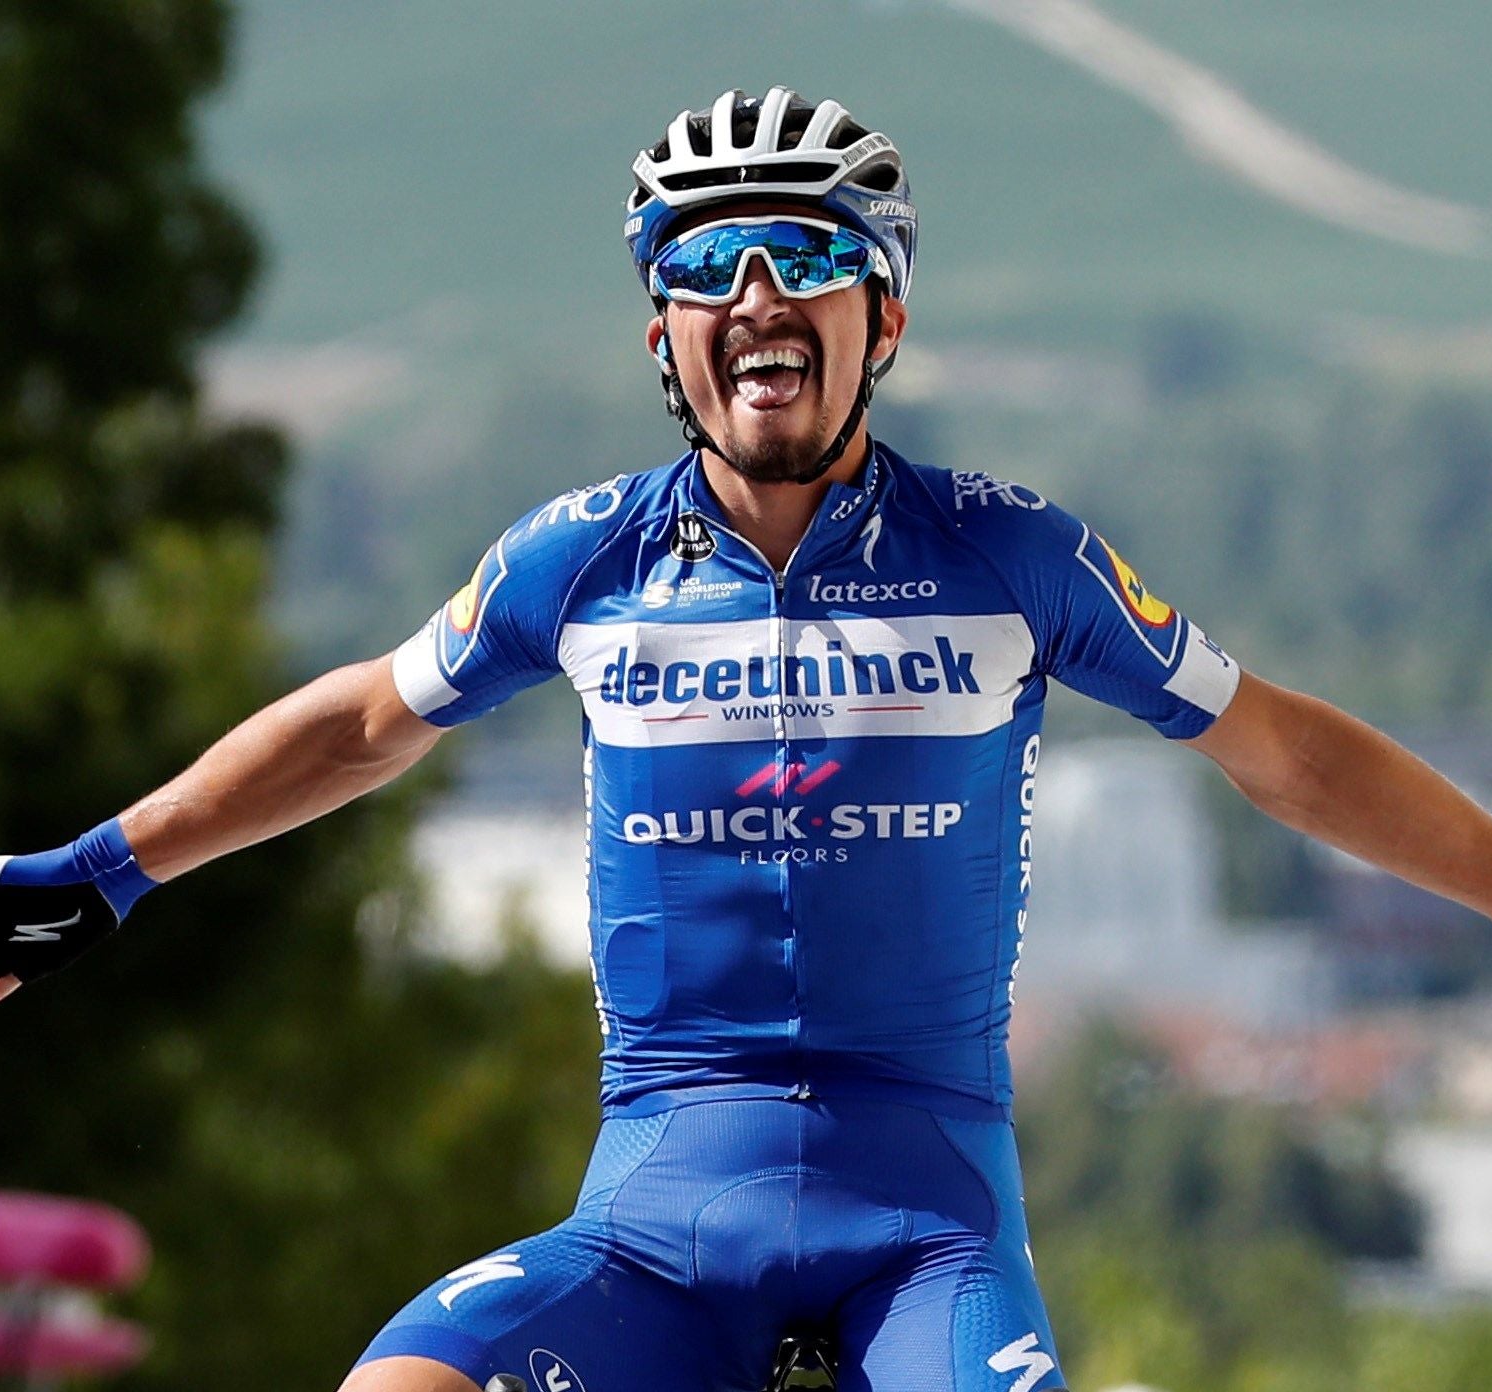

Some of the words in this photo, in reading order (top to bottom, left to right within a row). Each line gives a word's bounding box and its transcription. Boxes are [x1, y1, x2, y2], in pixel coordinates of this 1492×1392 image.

[809, 575, 938, 602] latexco
[600, 636, 982, 706] deceuninck
[721, 703, 835, 721] WINDOWS
[740, 847, 849, 865] FLOORS
